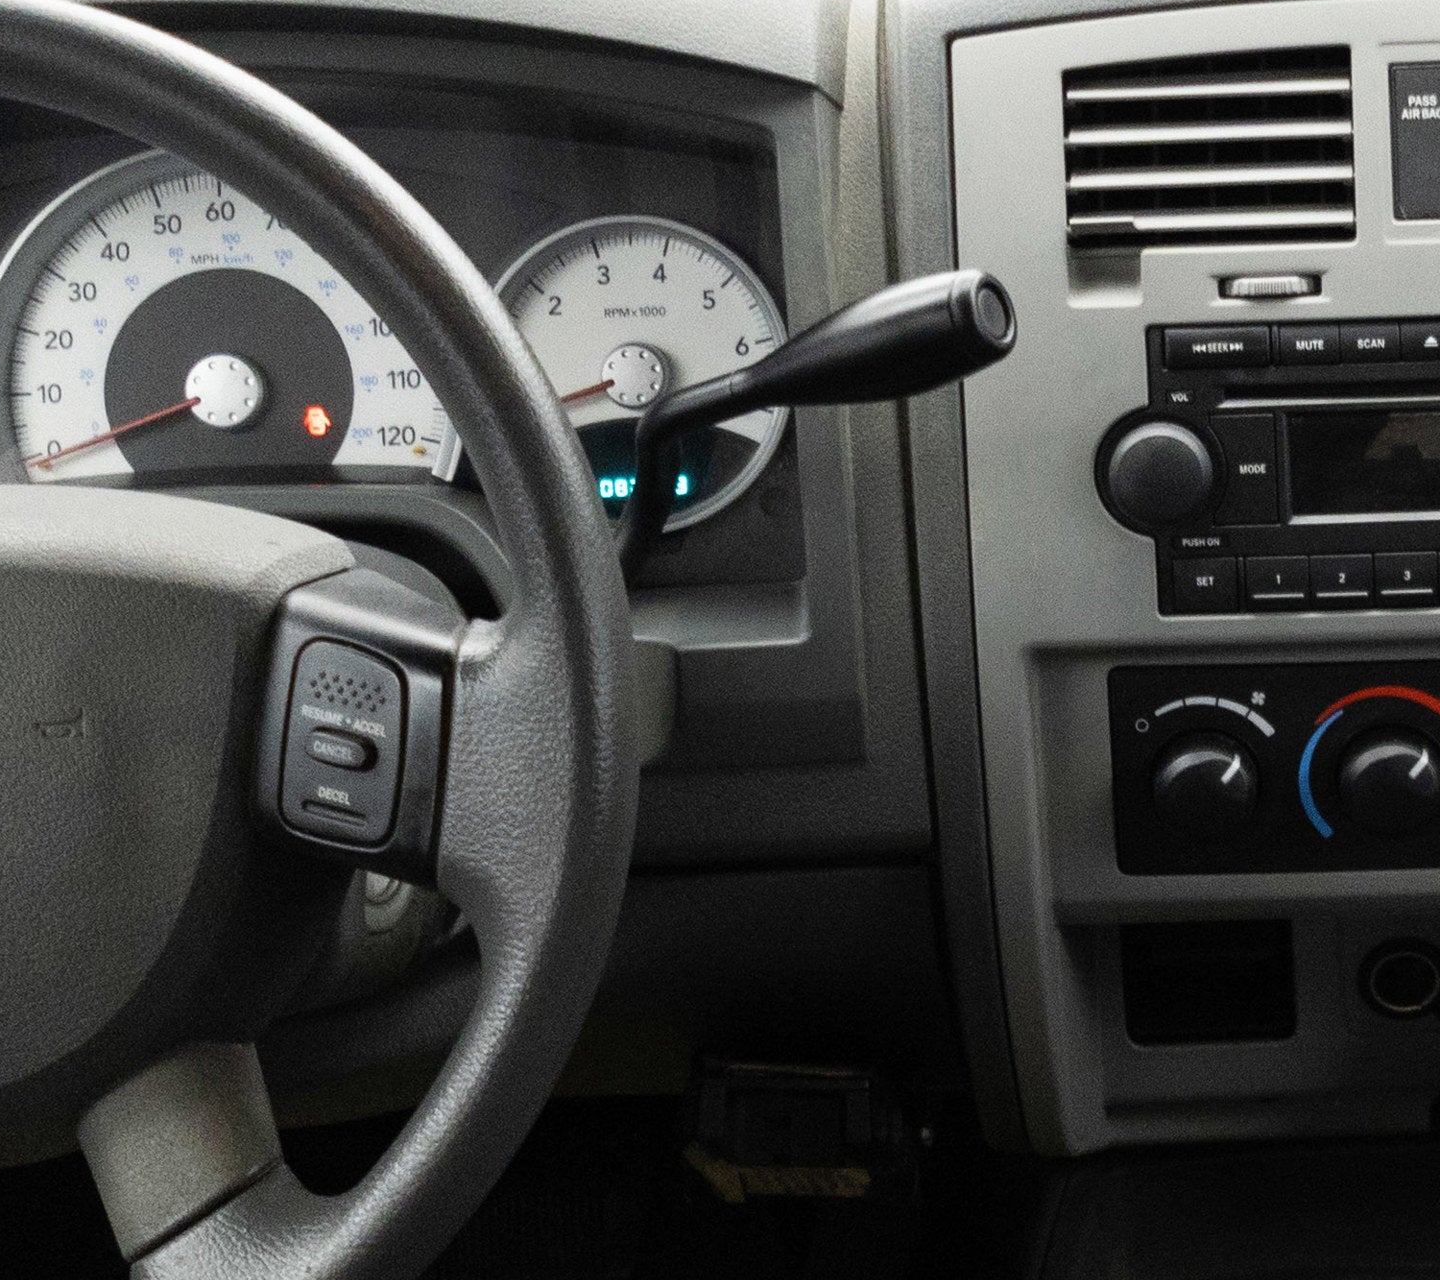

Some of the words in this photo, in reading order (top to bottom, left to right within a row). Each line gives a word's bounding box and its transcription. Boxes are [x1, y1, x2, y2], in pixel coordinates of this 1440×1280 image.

[1407, 94, 1437, 107] PASS
[1401, 107, 1421, 120] AIR
[205, 200, 235, 221] 60
[152, 213, 182, 234] 50
[100, 241, 130, 262] 40
[190, 253, 220, 265] MPH
[223, 252, 254, 265] km/h
[596, 265, 611, 286] 3
[652, 262, 668, 284] 4
[68, 281, 97, 303] 30
[702, 289, 717, 310] 5
[548, 295, 563, 317] 2
[44, 329, 74, 351] 20
[734, 336, 750, 357] 6
[1207, 344, 1229, 354] SEEK
[1295, 339, 1324, 352] MUTE
[1356, 338, 1386, 351] SCAN
[386, 369, 422, 390] 110
[37, 383, 62, 404] 10
[1171, 393, 1189, 404] VOL
[376, 425, 417, 447] 120
[46, 439, 63, 459] 0
[1239, 463, 1266, 475] MODE
[1182, 538, 1206, 548] PUSH
[1207, 537, 1220, 547] ON
[1196, 576, 1214, 587] SET
[1276, 574, 1281, 585] 1
[1339, 573, 1346, 584] 2
[1403, 570, 1411, 582] 3
